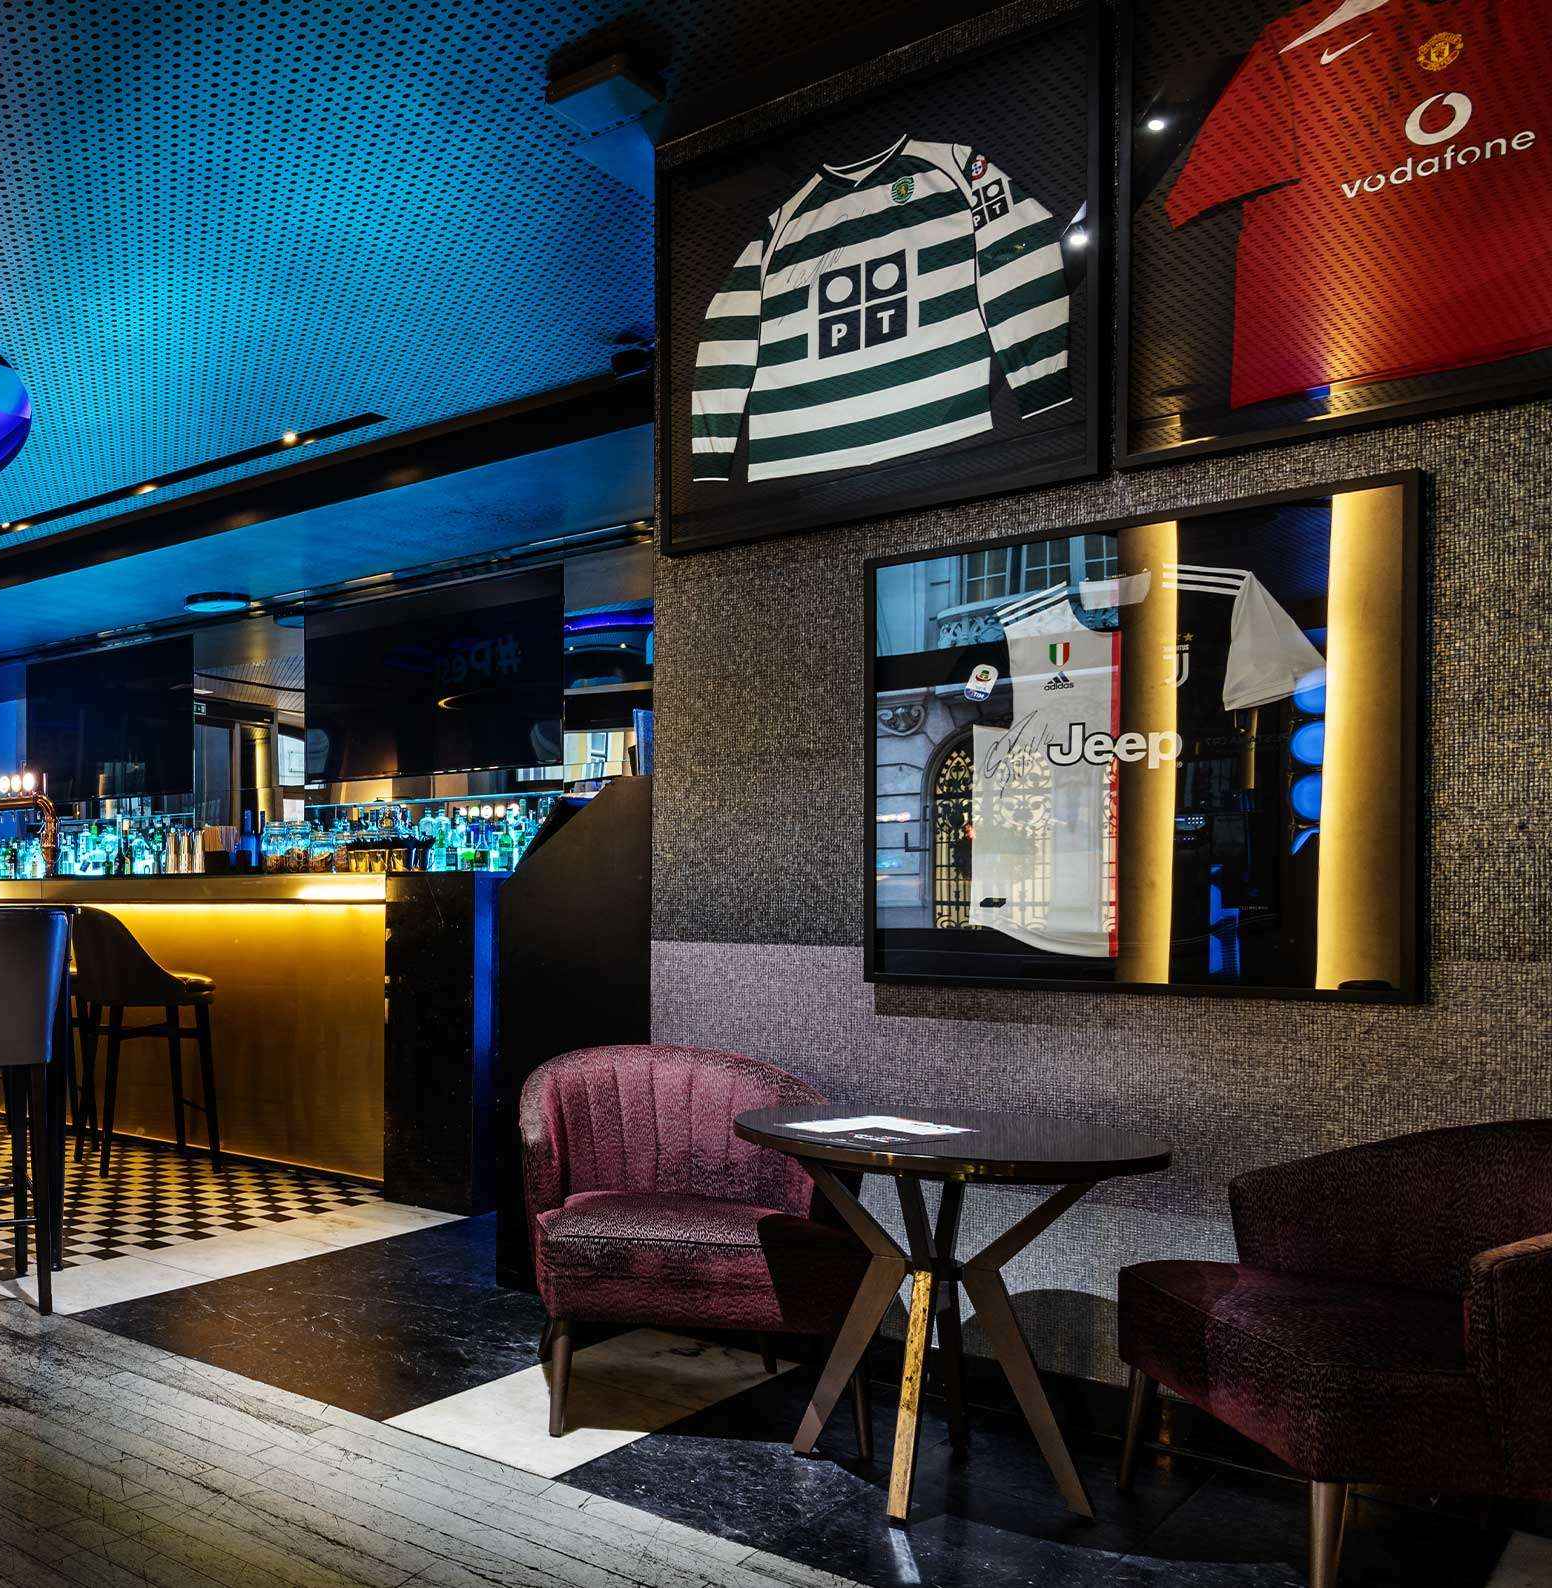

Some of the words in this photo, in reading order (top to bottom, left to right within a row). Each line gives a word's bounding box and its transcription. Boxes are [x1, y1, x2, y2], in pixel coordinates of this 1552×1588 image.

[1341, 130, 1536, 199] vodafone
[1044, 682, 1075, 691] adidas
[1048, 722, 1183, 769] Jeep
